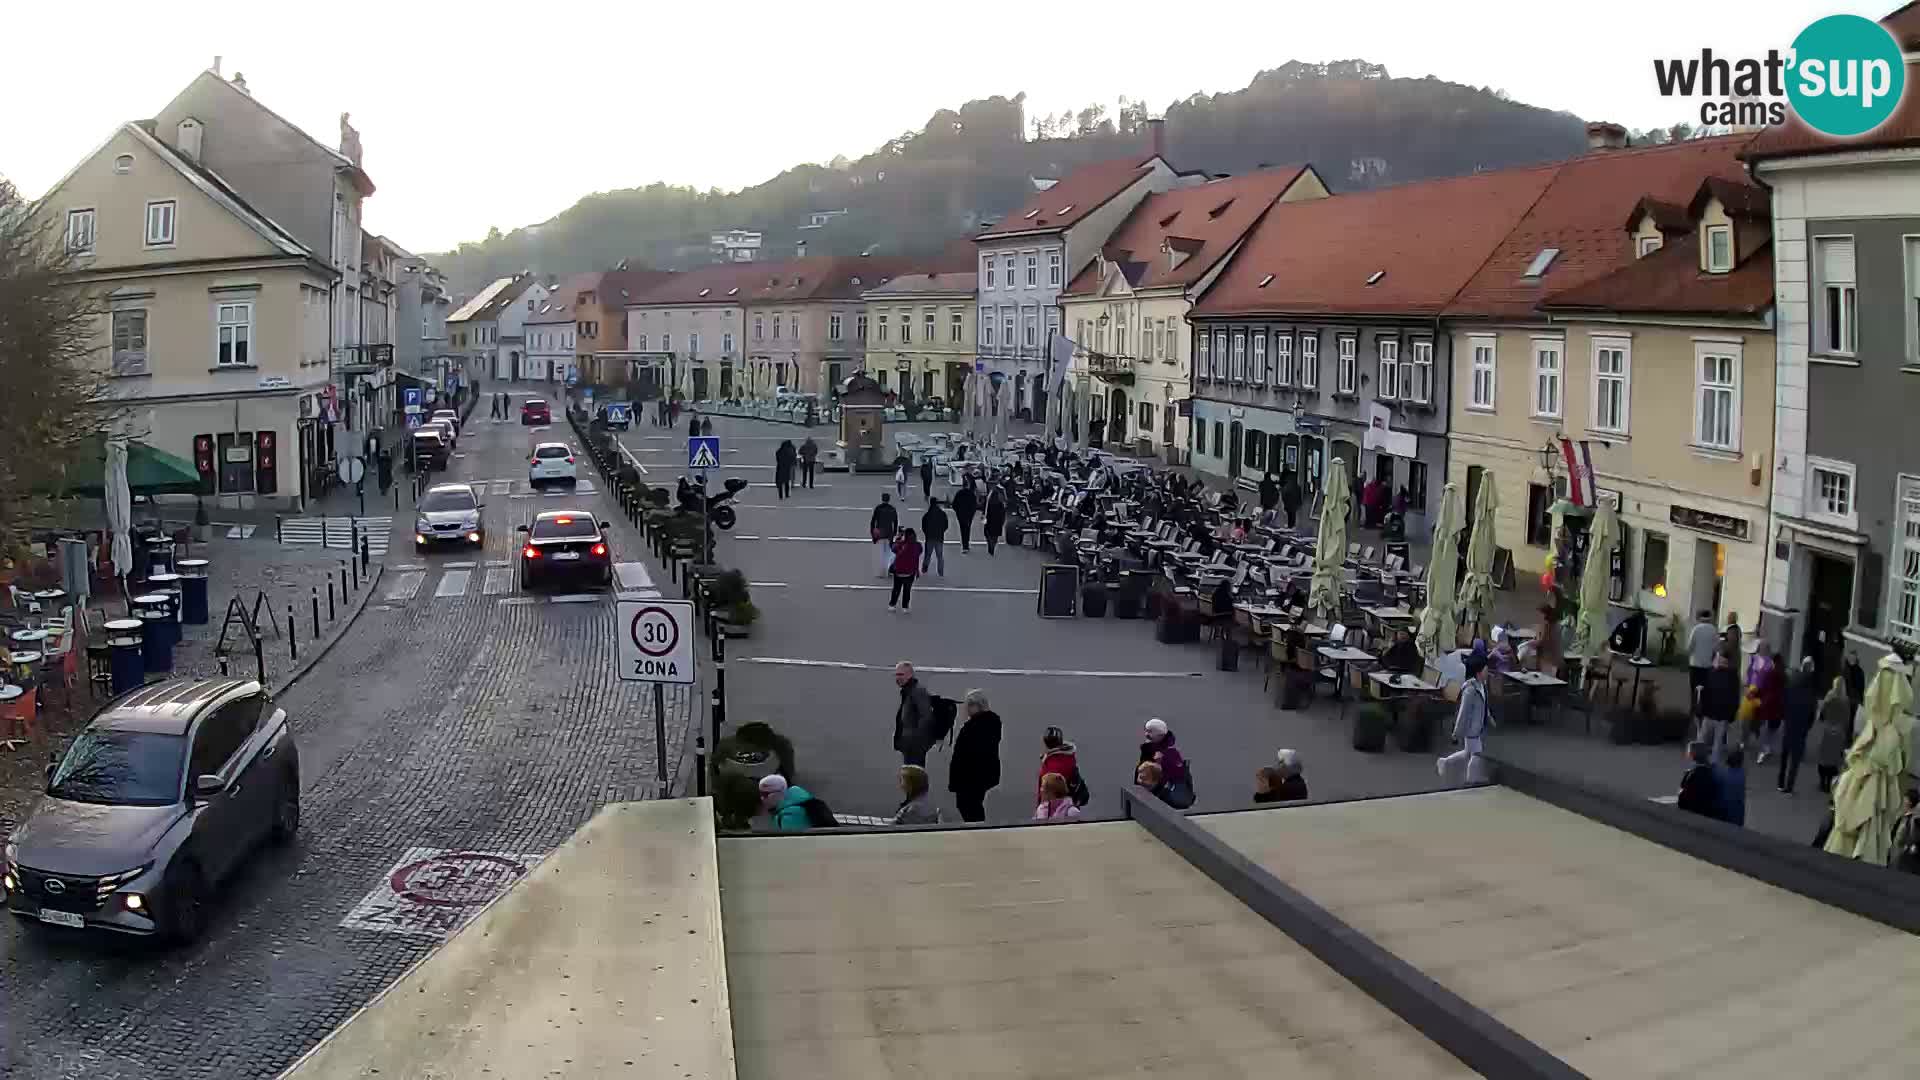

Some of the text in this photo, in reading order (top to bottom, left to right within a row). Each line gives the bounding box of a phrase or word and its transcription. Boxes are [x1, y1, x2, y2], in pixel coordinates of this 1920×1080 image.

[408, 391, 416, 403] P
[643, 622, 668, 643] 30
[633, 659, 678, 677] ZONA
